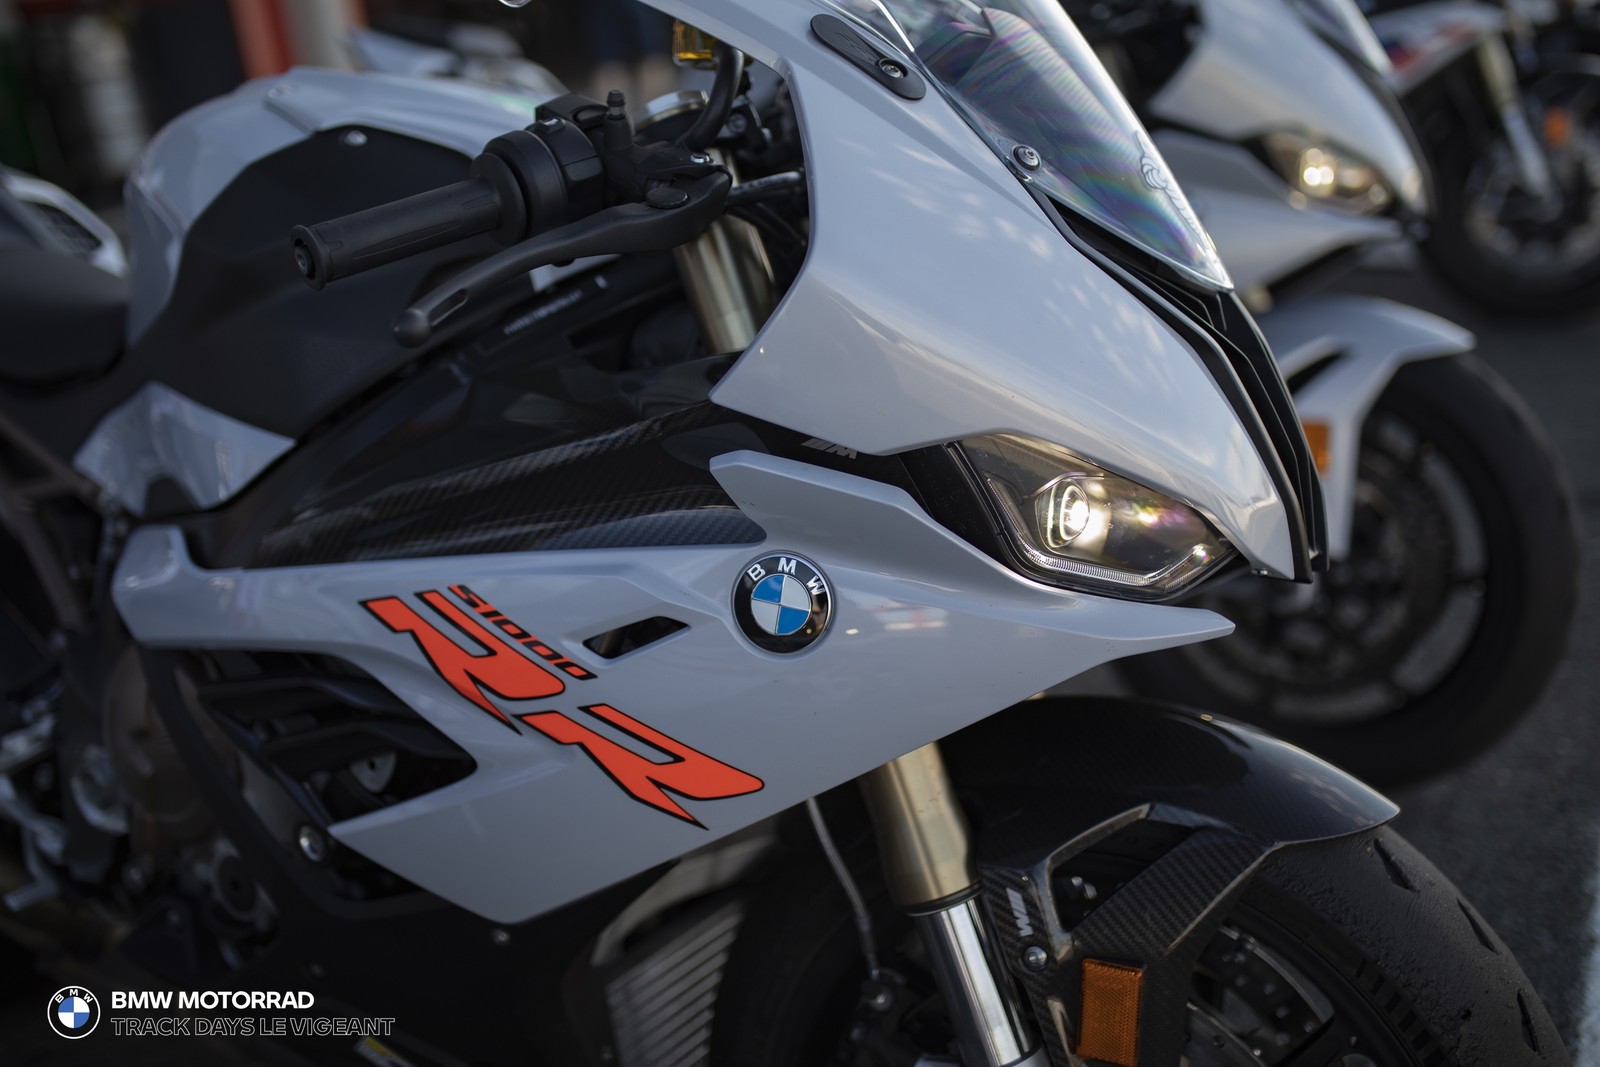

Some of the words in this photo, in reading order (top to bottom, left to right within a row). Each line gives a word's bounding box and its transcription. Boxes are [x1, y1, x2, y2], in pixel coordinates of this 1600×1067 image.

[746, 557, 826, 596] BMW
[447, 584, 598, 681] S1000
[357, 588, 766, 832] RR
